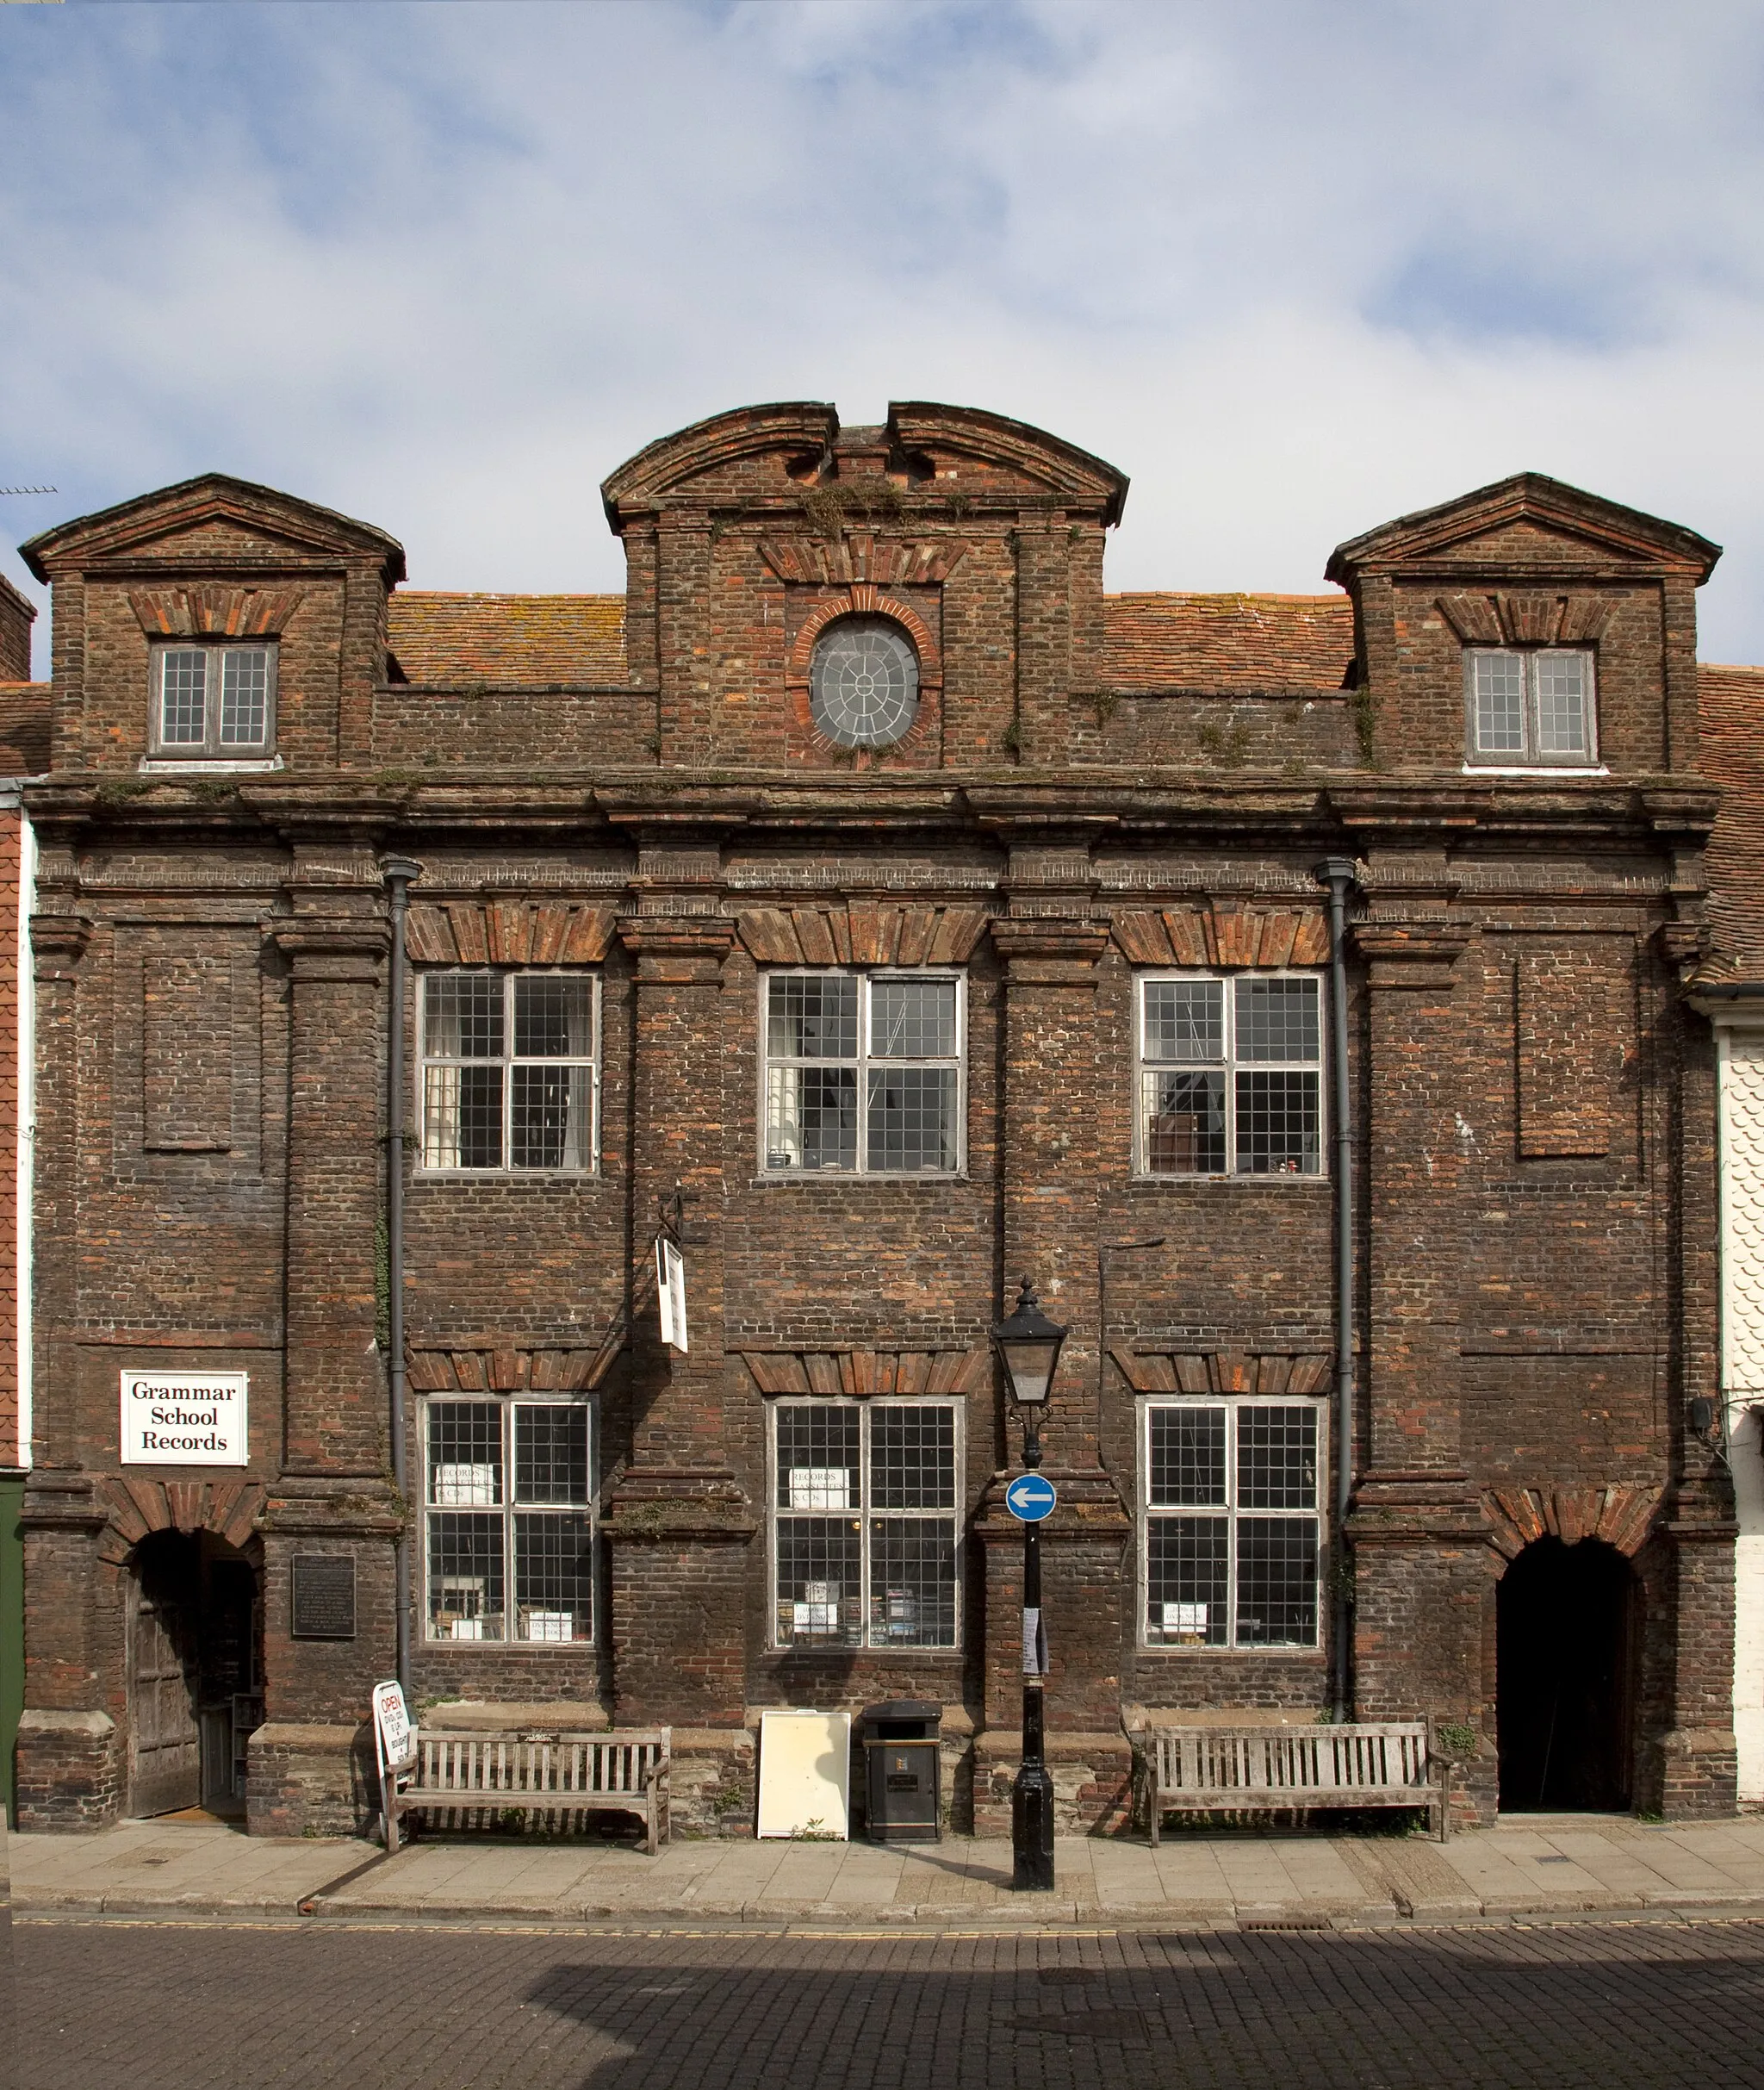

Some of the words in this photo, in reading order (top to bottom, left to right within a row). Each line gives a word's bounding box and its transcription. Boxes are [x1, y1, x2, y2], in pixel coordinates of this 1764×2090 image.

[132, 1381, 236, 1401] Grammar
[151, 1407, 218, 1426] School
[141, 1431, 227, 1451] Records
[793, 1472, 836, 1481] RECORDS
[382, 1695, 402, 1714] OPEN
